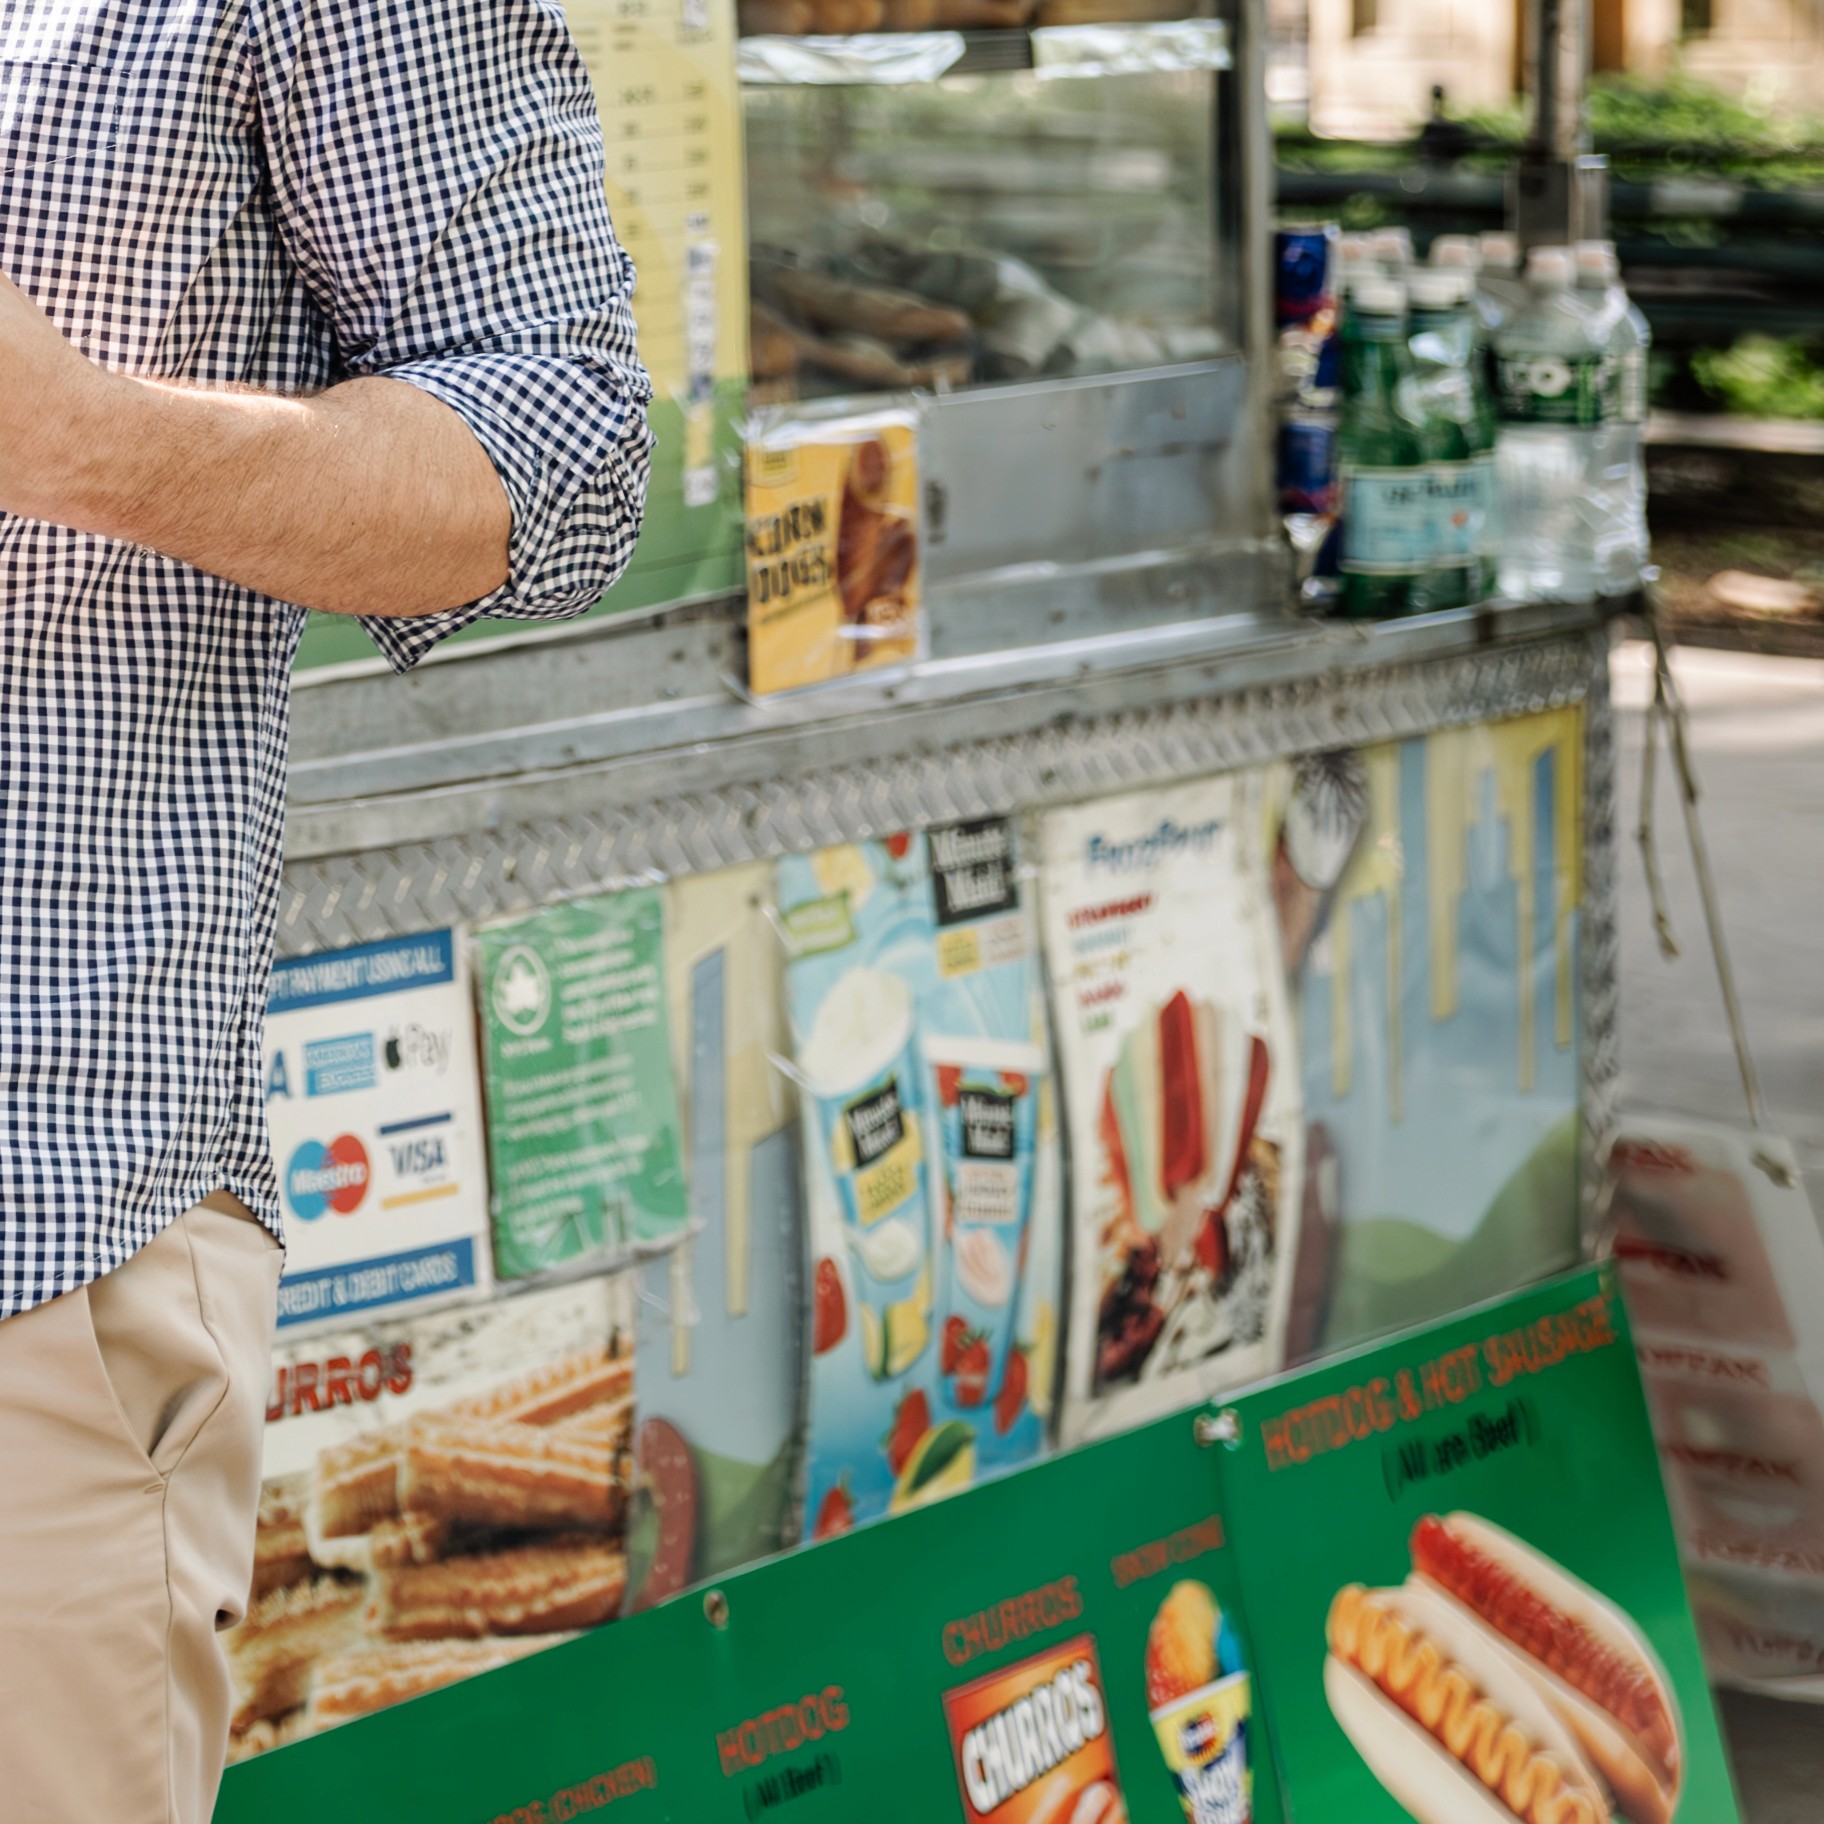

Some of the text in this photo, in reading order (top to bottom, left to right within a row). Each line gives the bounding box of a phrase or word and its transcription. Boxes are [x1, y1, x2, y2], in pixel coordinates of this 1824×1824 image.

[389, 1136, 447, 1177] VISA
[1259, 1386, 1395, 1472] HOTDOG
[1420, 1344, 1483, 1412] HOT
[942, 1578, 1083, 1666] CHURROS
[715, 1684, 852, 1779] HOTDOG
[961, 1659, 1104, 1814] CHURROS
